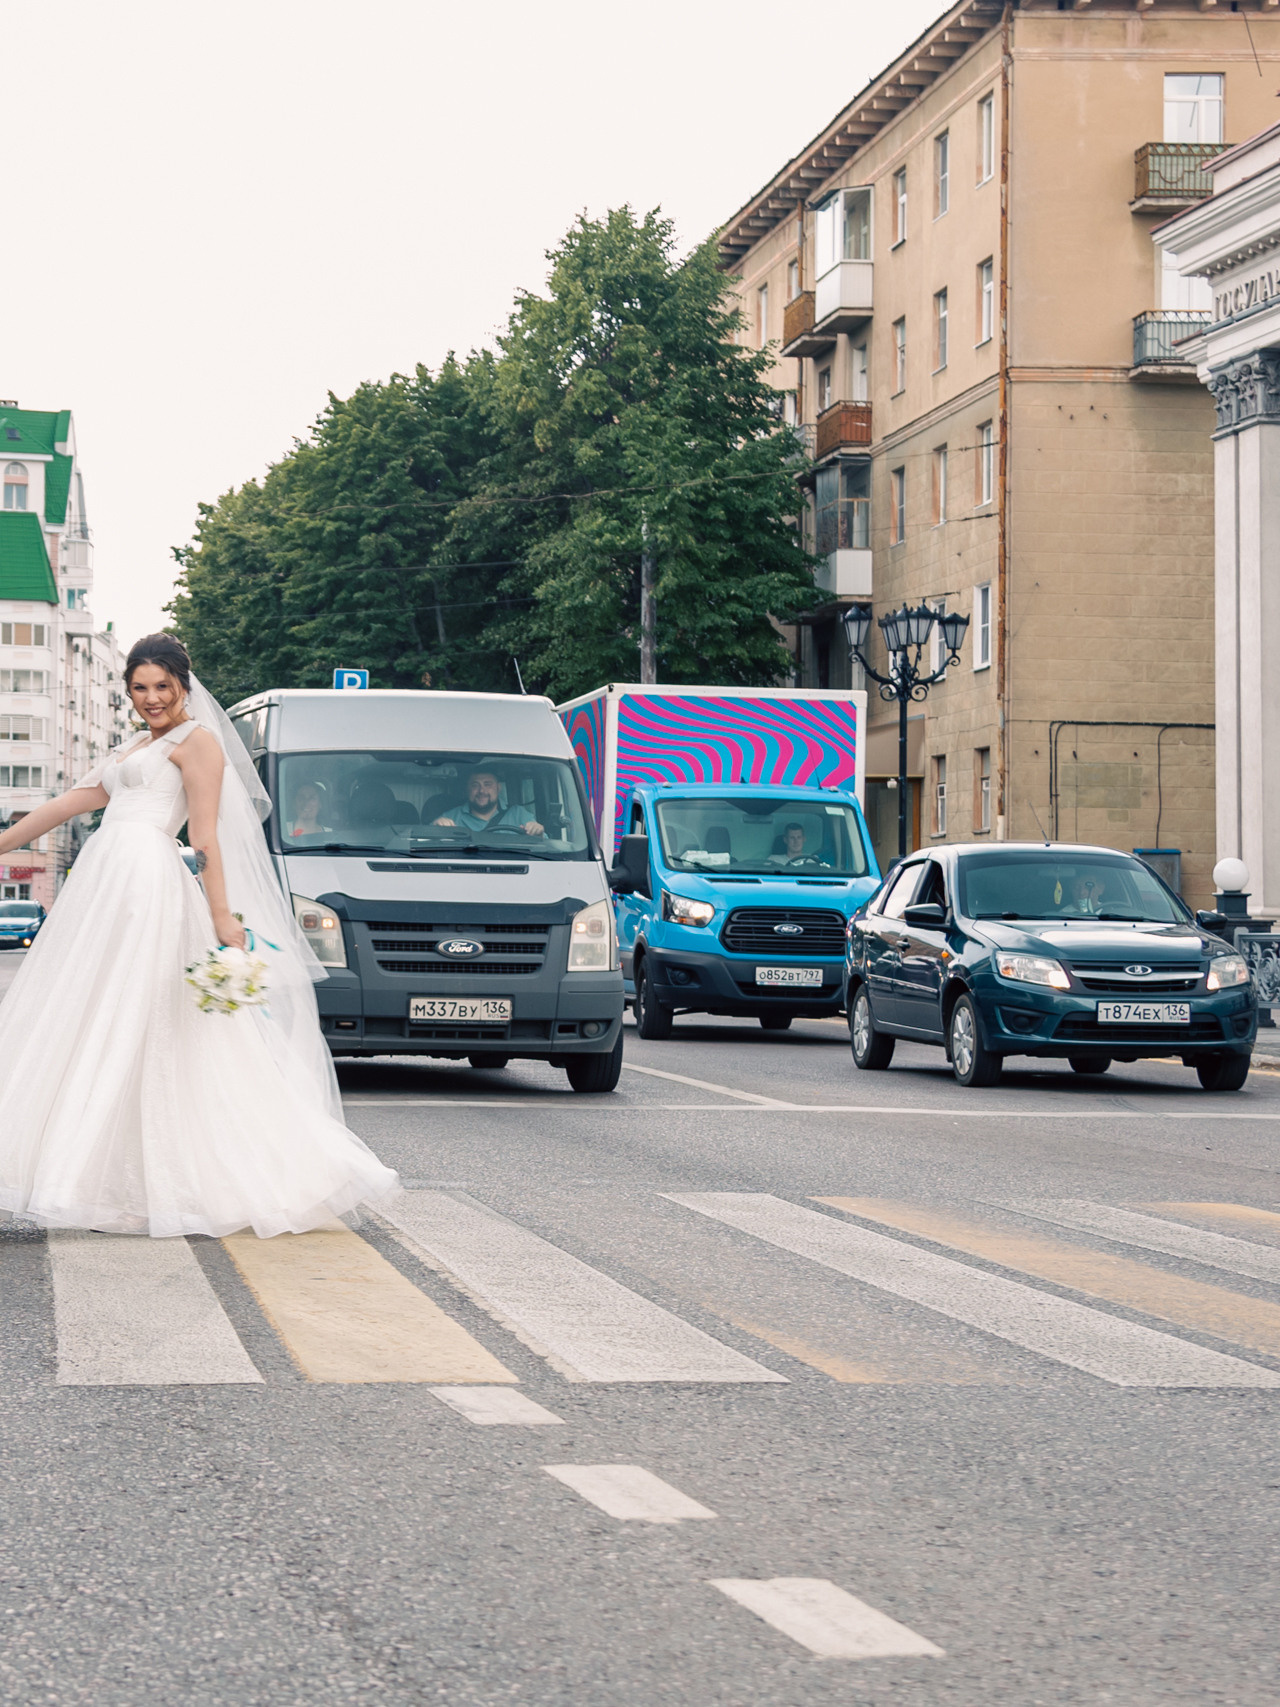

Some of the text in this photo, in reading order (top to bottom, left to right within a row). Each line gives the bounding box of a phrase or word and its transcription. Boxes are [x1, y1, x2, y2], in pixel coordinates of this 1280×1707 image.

[448, 942, 473, 953] Ford
[759, 969, 820, 981] О852ВТ 797
[415, 1001, 506, 1017] М337ВУ 136
[1103, 1005, 1186, 1020] Т874ЕХ 136
